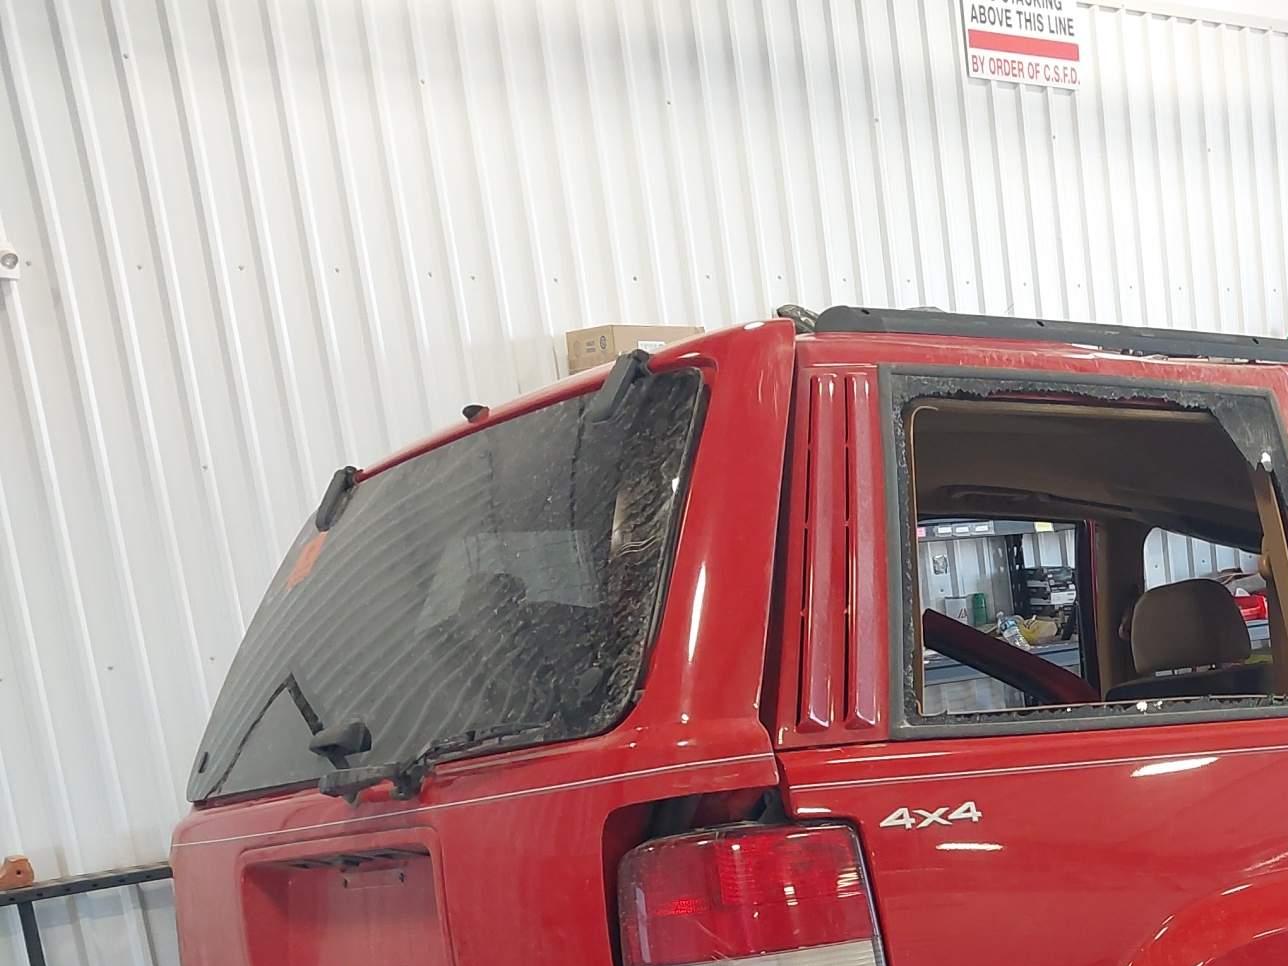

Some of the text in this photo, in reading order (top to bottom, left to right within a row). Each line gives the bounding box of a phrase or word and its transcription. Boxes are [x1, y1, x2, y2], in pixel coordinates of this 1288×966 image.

[971, 3, 1013, 28] ABOVE
[1016, 10, 1044, 32] THIS
[1047, 14, 1075, 37] LINE
[971, 54, 1080, 86] BY ORDER OF C.S.F.D.
